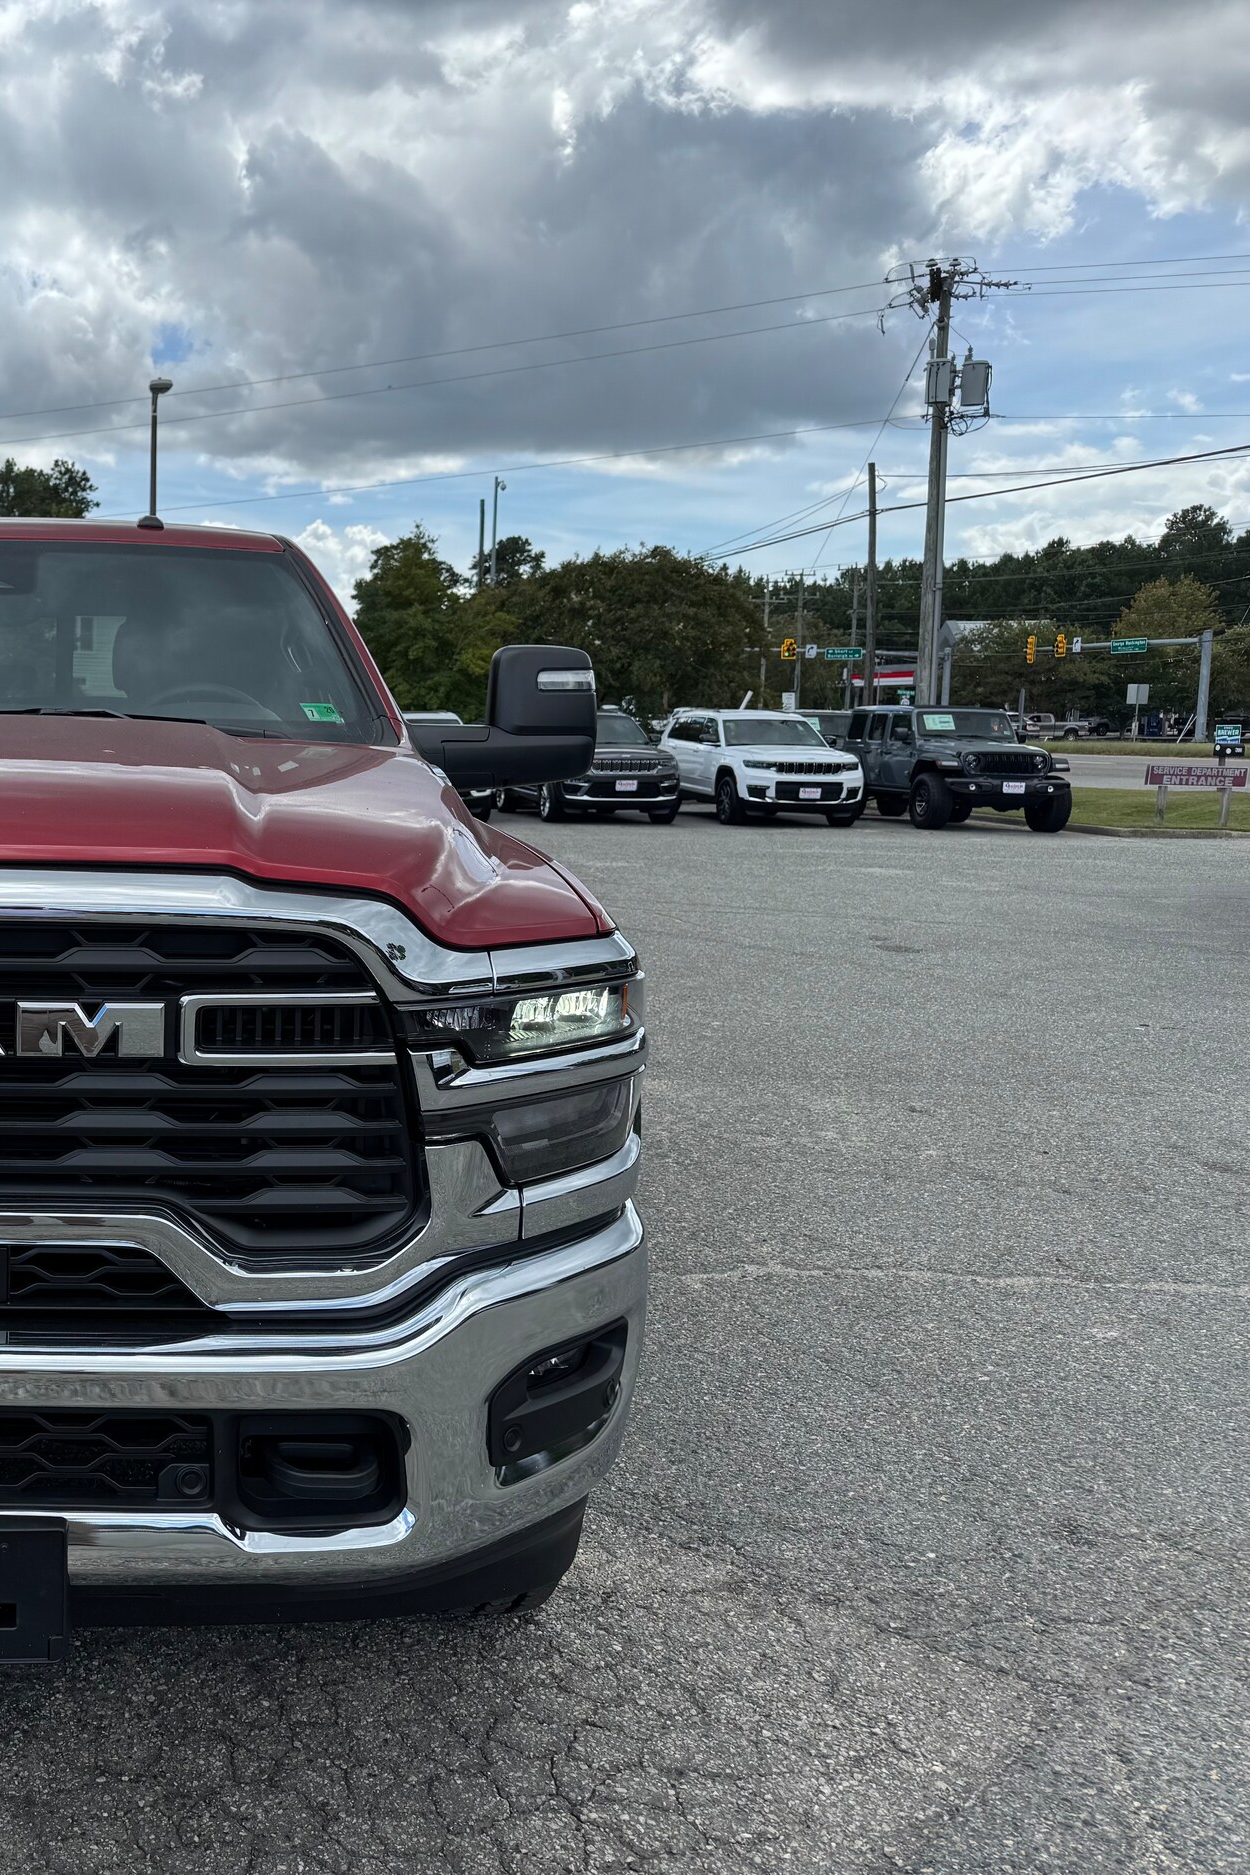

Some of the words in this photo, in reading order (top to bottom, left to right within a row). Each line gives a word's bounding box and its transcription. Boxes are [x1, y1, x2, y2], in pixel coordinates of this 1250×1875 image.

[1153, 766, 1188, 775] SERVICE
[1191, 767, 1246, 777] DEPARTMENT
[1162, 775, 1234, 786] ENTRANCE
